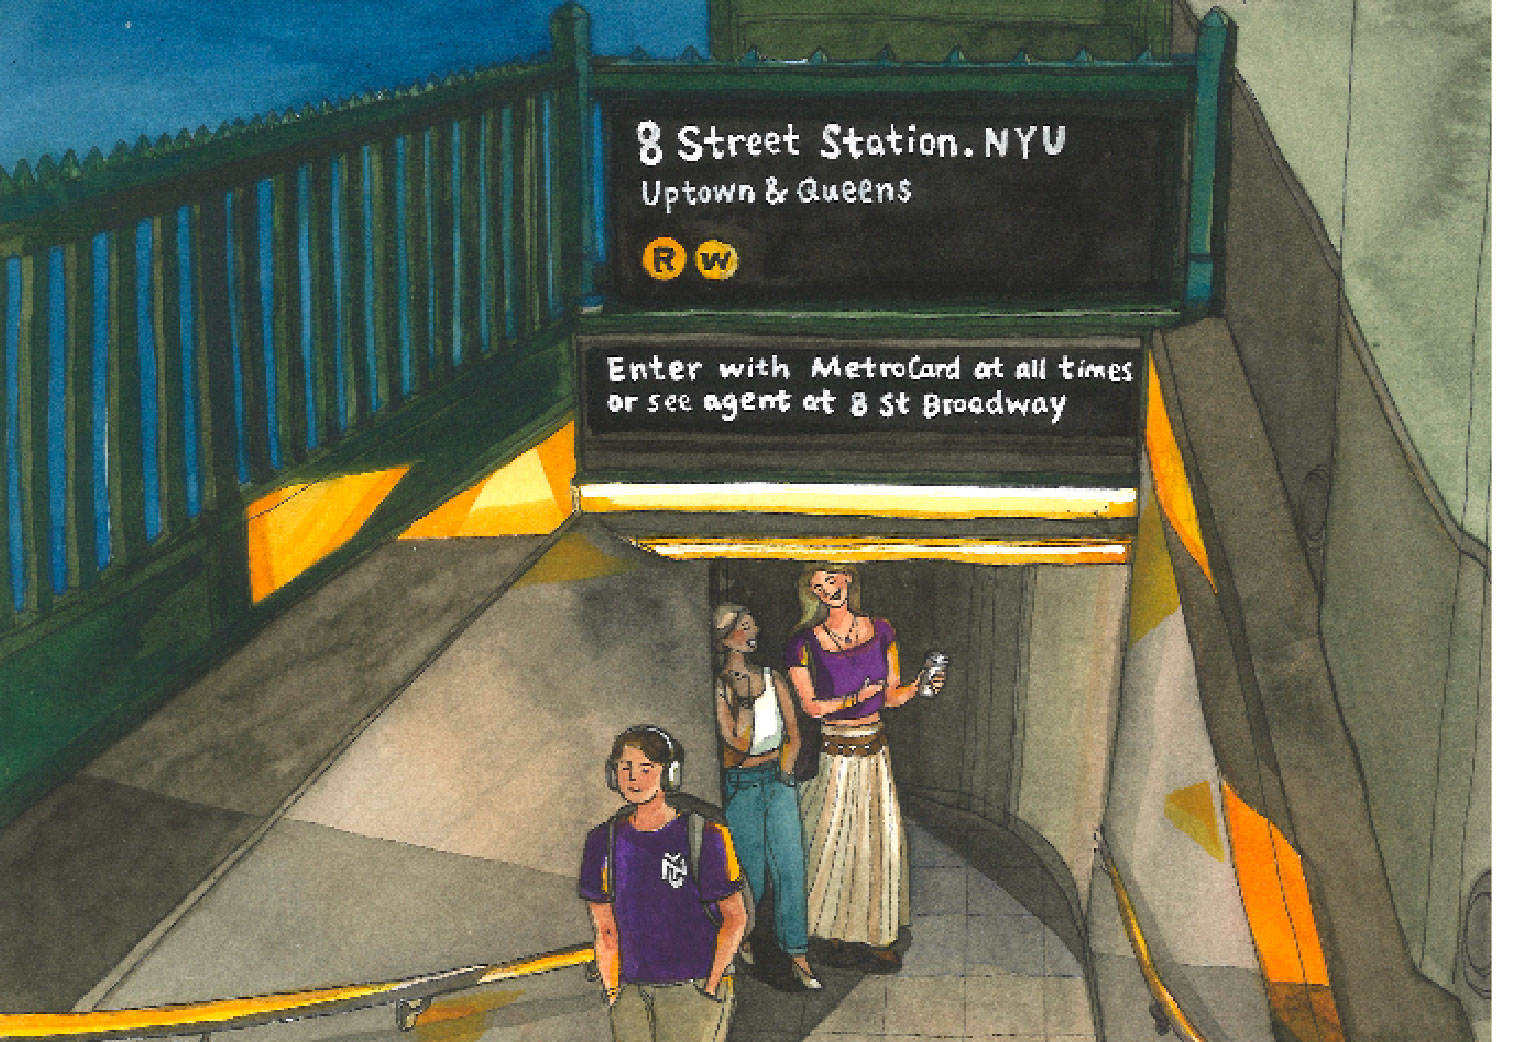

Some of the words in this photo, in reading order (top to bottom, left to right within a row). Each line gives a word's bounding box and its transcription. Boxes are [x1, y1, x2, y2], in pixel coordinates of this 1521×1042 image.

[636, 119, 663, 166] 8
[678, 123, 800, 162] Street
[985, 125, 1066, 160] NYU
[642, 180, 756, 216] Uptown
[765, 175, 789, 206] &
[796, 175, 912, 204] Queens
[607, 354, 703, 382] Enter
[719, 354, 791, 380] with
[811, 354, 960, 380] MetroCard
[972, 356, 1004, 380] at
[1014, 354, 1046, 380] all
[1058, 354, 1134, 382] times
[606, 393, 639, 414] or
[646, 393, 693, 414] see
[703, 388, 793, 422] agent
[802, 388, 837, 415] at
[848, 391, 868, 417] 8
[879, 390, 910, 417] St
[921, 389, 1067, 424] Broadway
